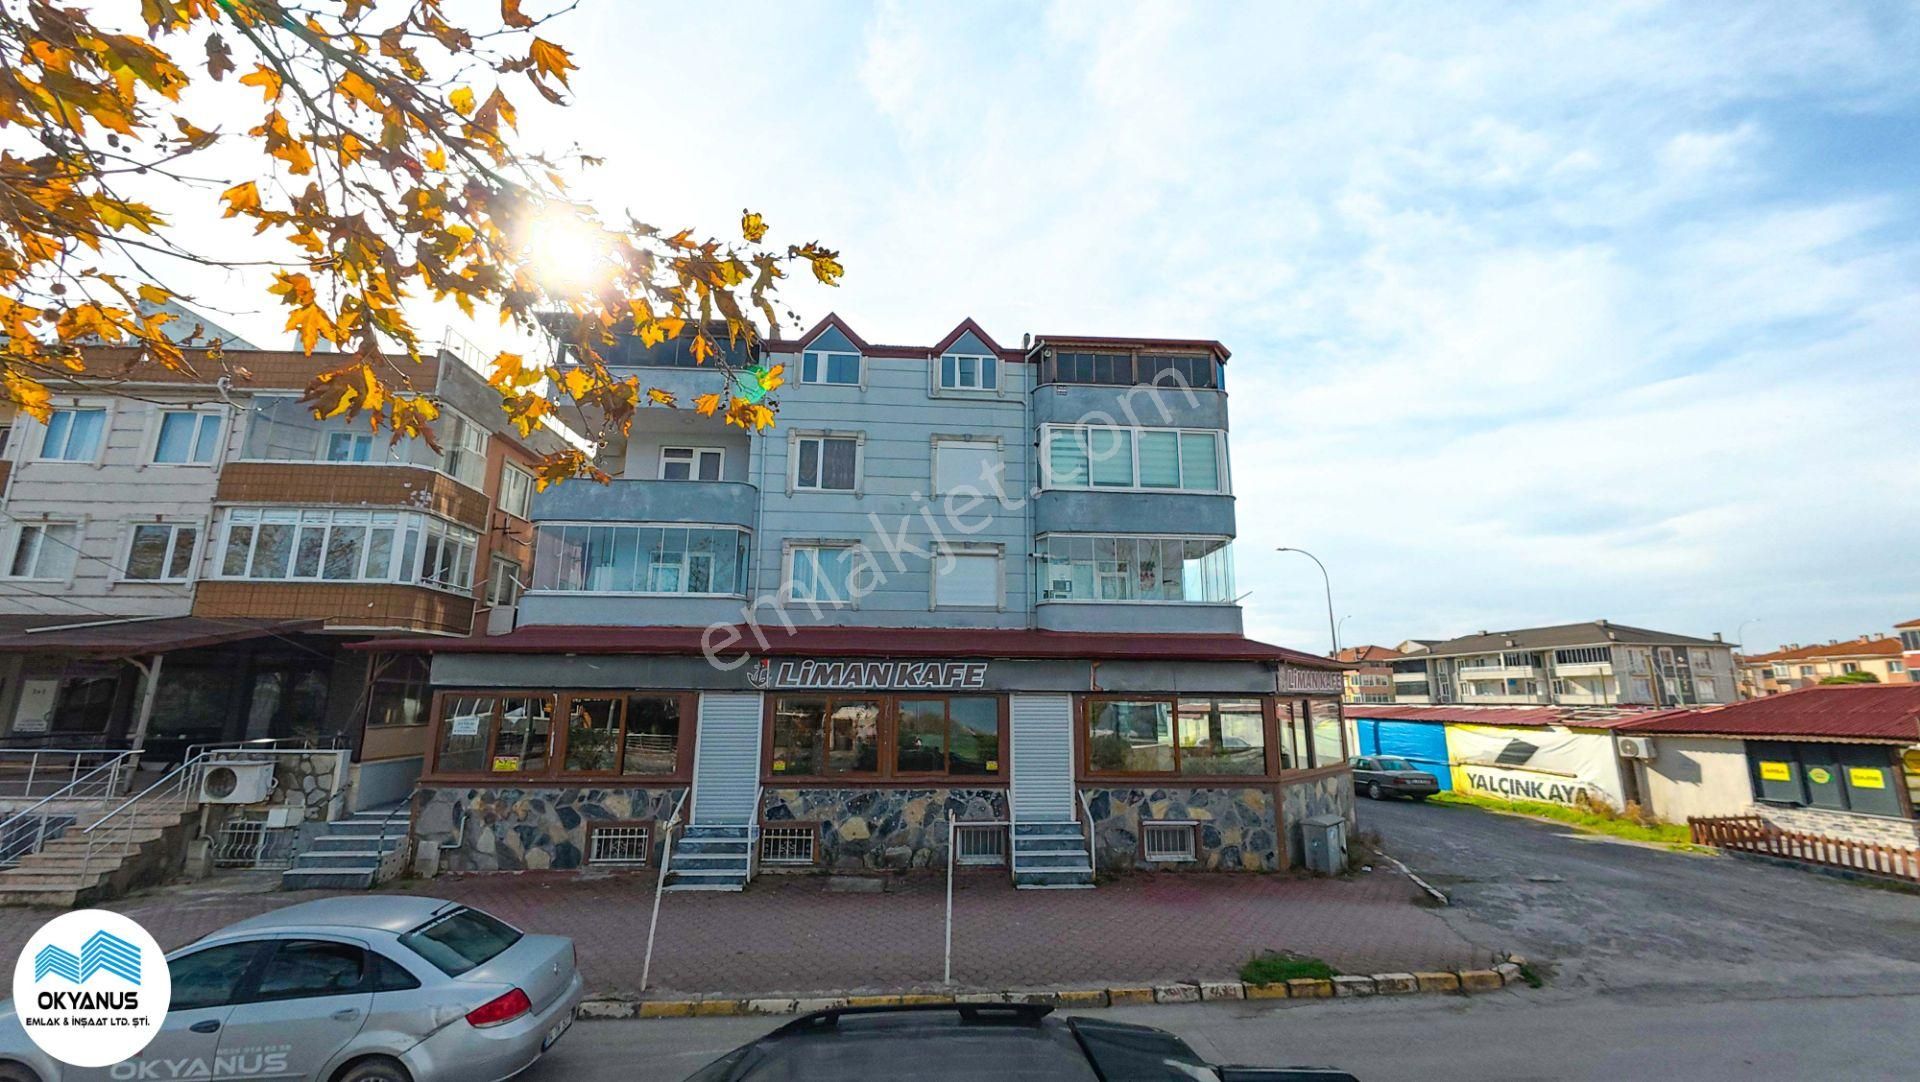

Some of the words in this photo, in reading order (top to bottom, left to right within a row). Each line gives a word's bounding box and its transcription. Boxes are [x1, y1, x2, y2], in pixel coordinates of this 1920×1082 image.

[894, 663, 987, 688] KAFE
[1319, 671, 1342, 690] KAFE
[110, 1053, 288, 1080] OKYANUS
